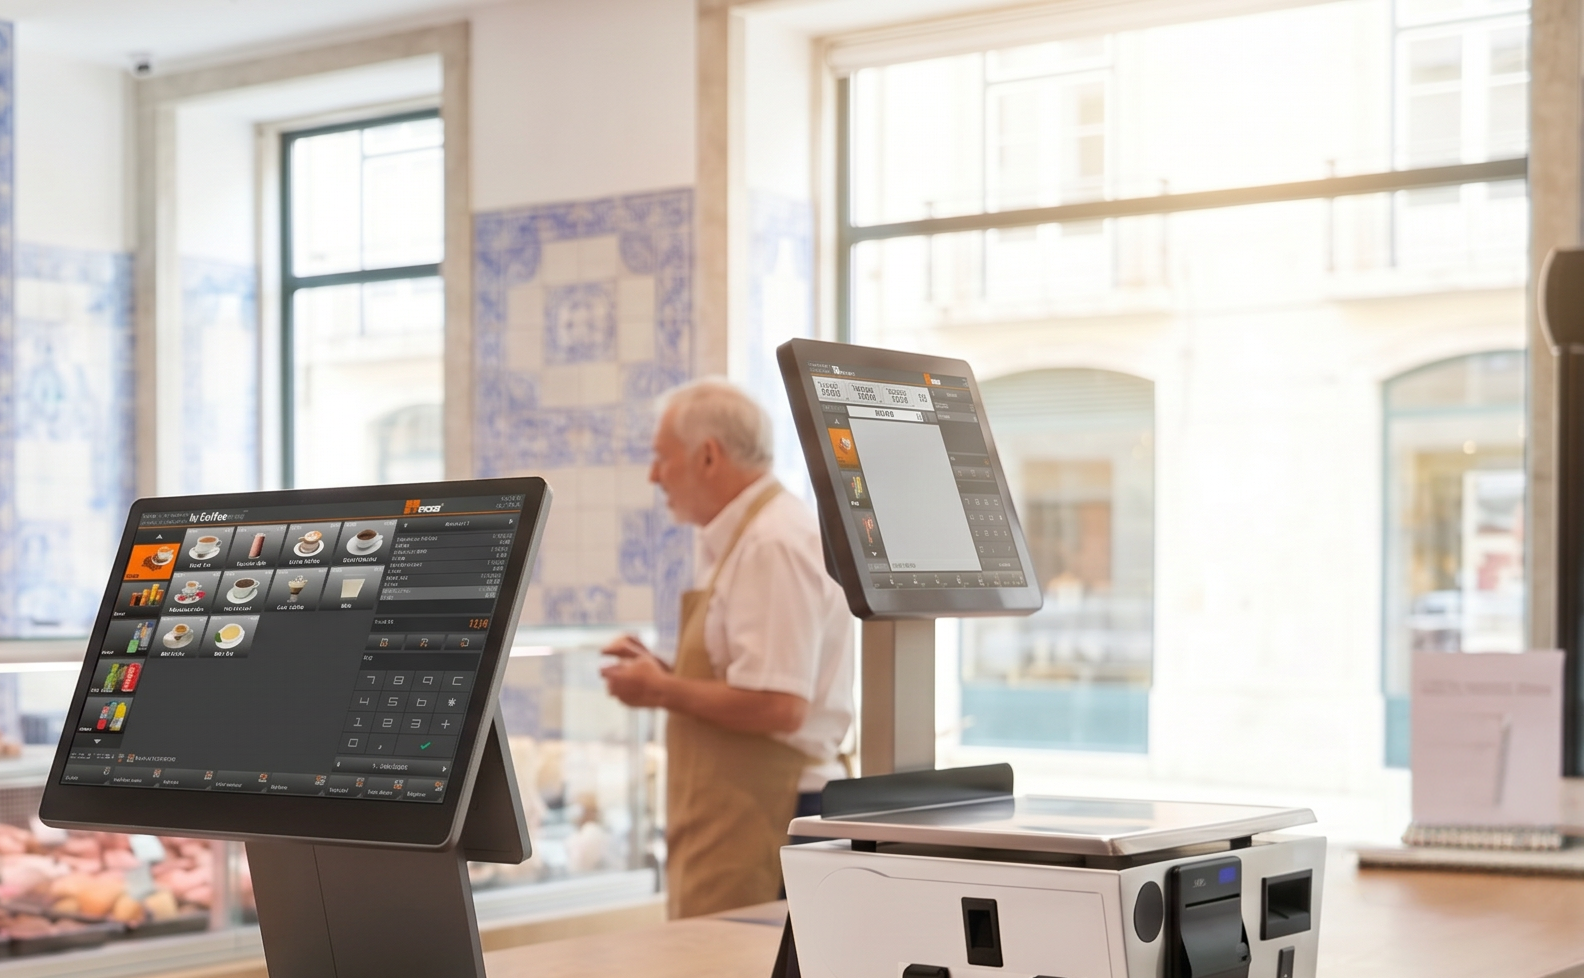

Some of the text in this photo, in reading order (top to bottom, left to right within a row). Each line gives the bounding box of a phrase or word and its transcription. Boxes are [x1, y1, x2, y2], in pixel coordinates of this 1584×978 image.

[366, 675, 376, 684] 7
[393, 675, 404, 685] 8
[452, 676, 463, 686] C
[359, 697, 370, 706] 4
[387, 697, 399, 707] 5
[410, 719, 422, 729] 3
